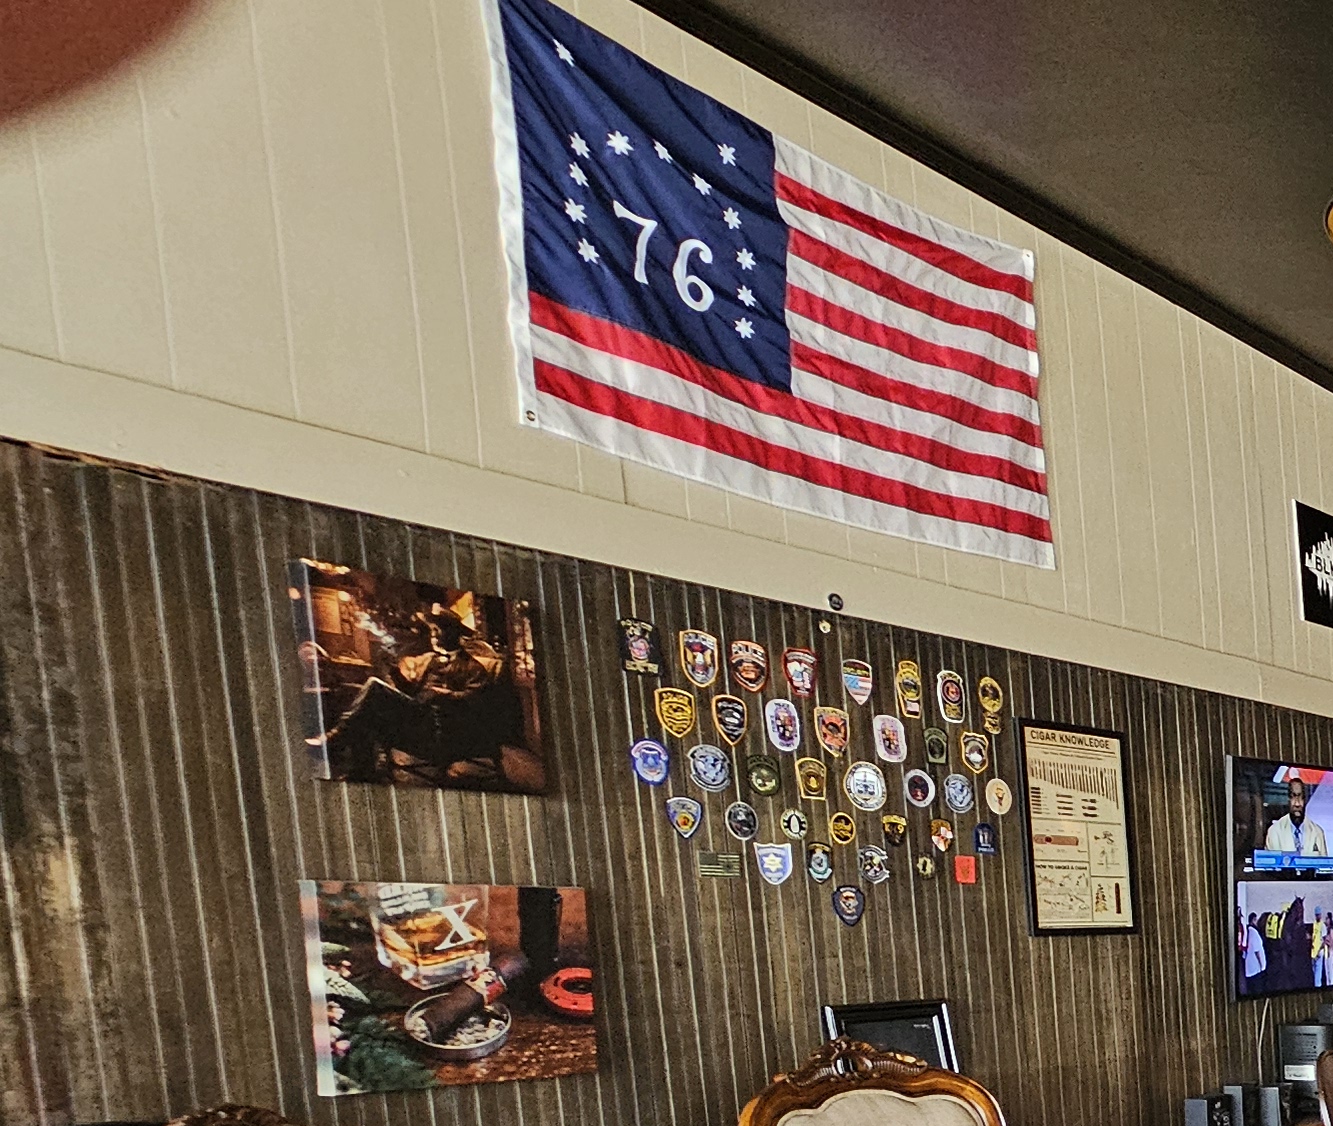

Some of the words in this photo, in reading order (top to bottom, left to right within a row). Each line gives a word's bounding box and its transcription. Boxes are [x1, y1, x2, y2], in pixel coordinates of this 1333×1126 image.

[613, 200, 715, 312] 76
[1030, 729, 1057, 743] CIGAR
[1060, 733, 1111, 750] KNOWLEDGE
[430, 898, 479, 951] X
